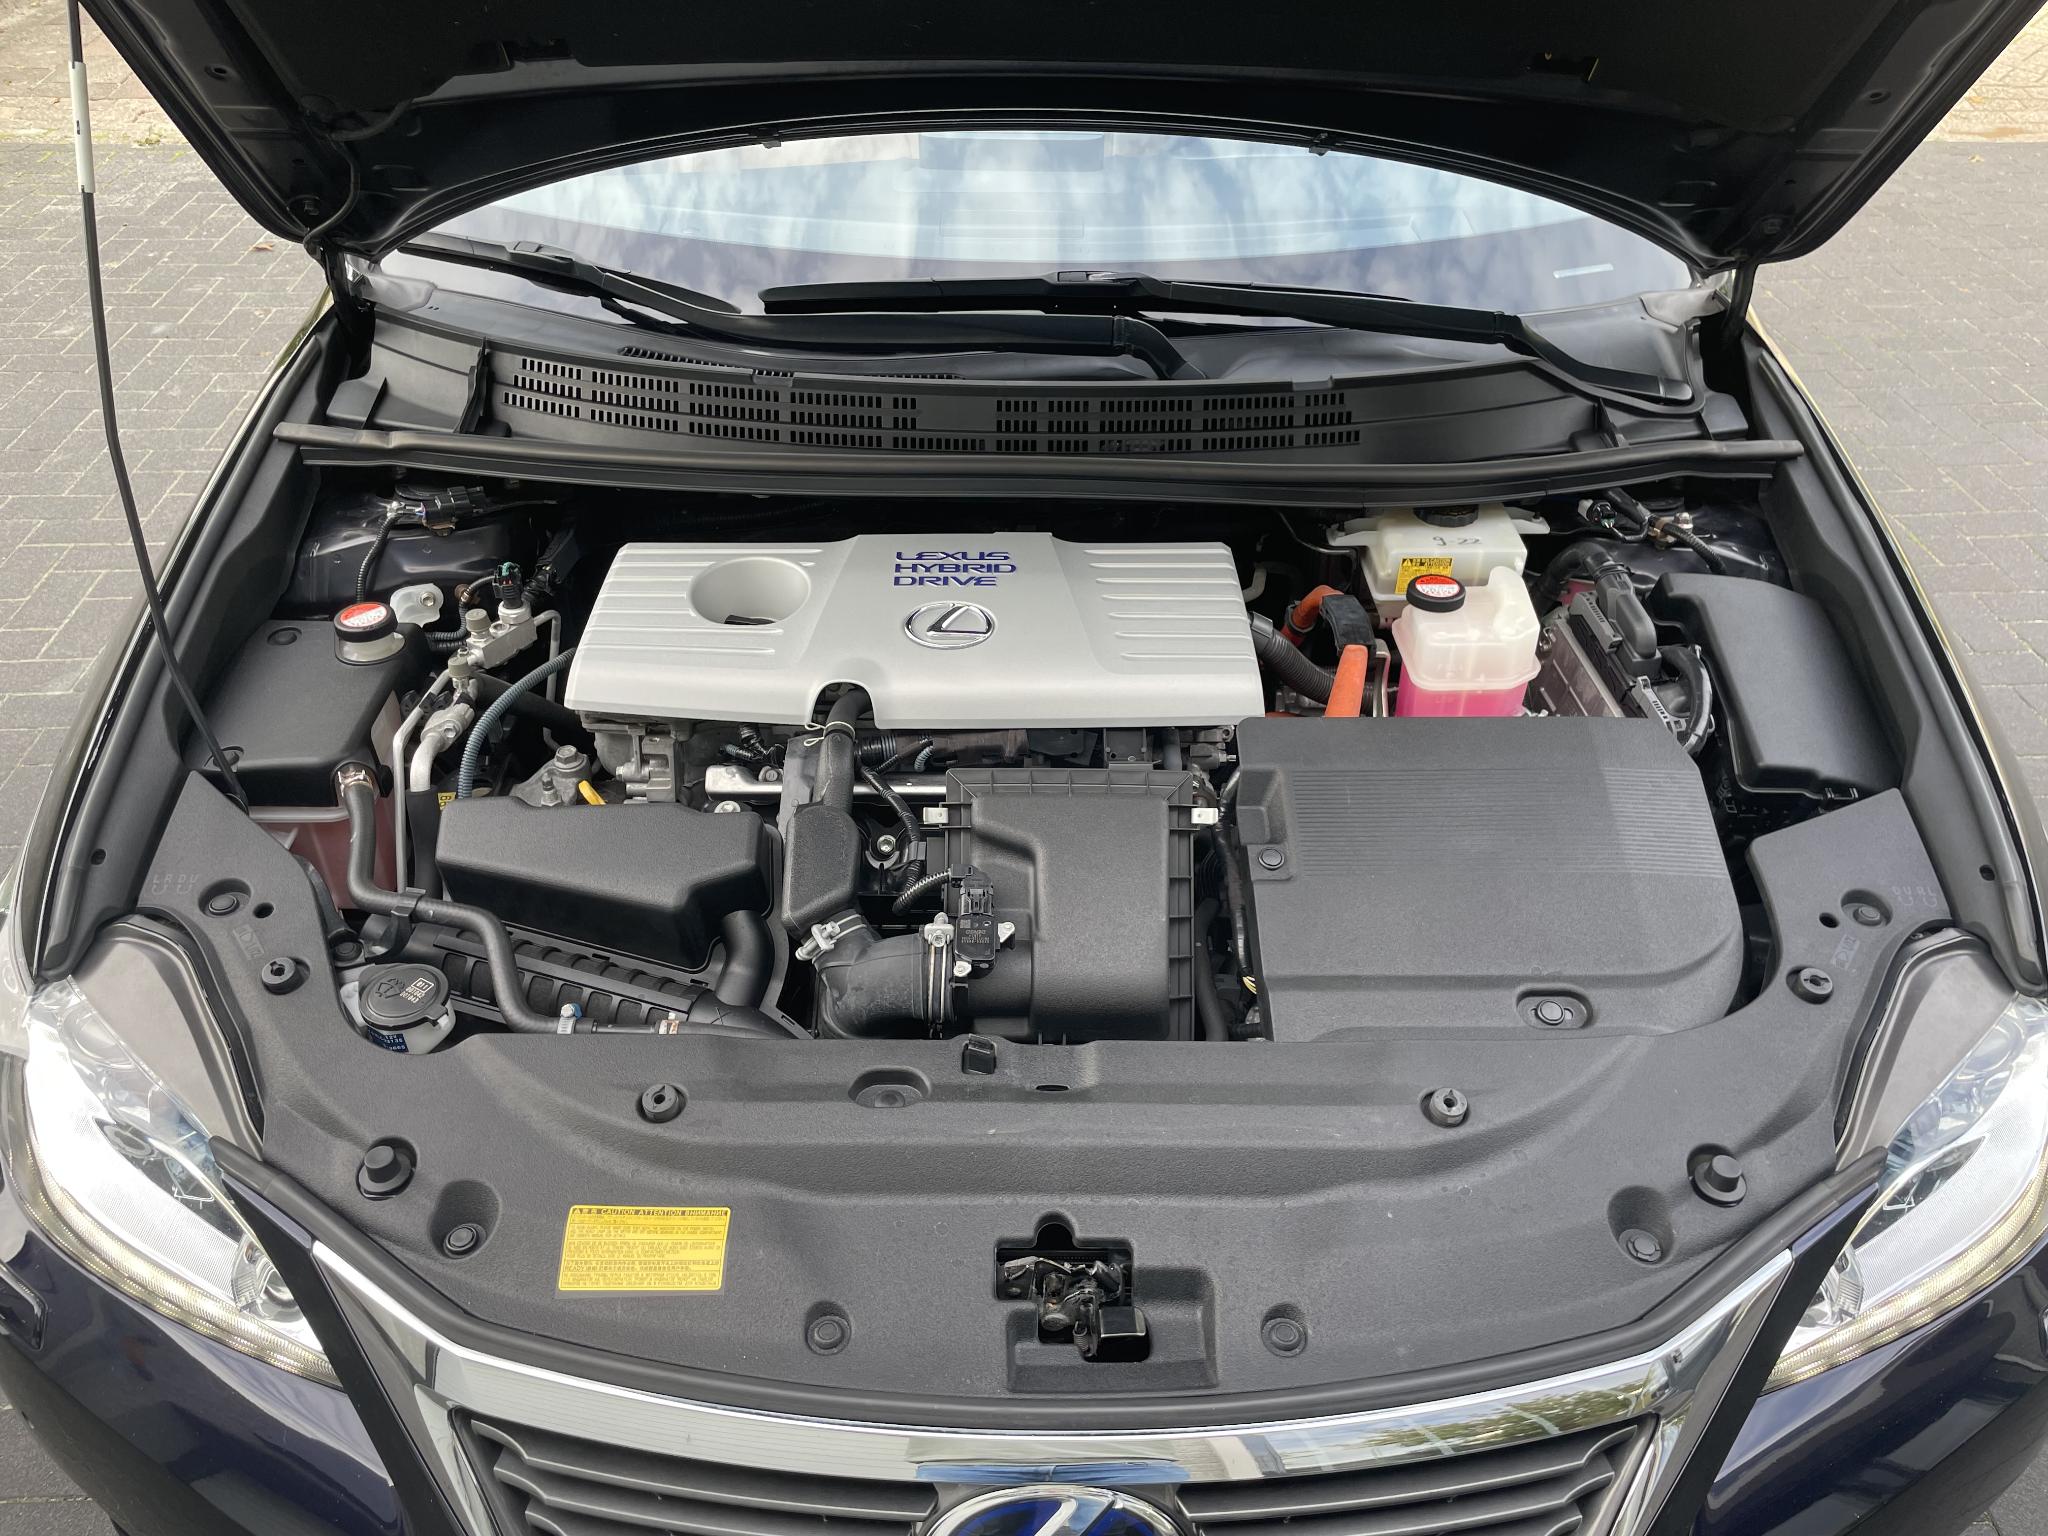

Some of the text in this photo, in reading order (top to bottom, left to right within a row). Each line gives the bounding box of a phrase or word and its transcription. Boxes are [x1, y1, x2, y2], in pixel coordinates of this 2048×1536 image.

[895, 551, 1011, 561] LEXUS
[894, 563, 1017, 574] HYBRID
[893, 576, 998, 587] DRIVE
